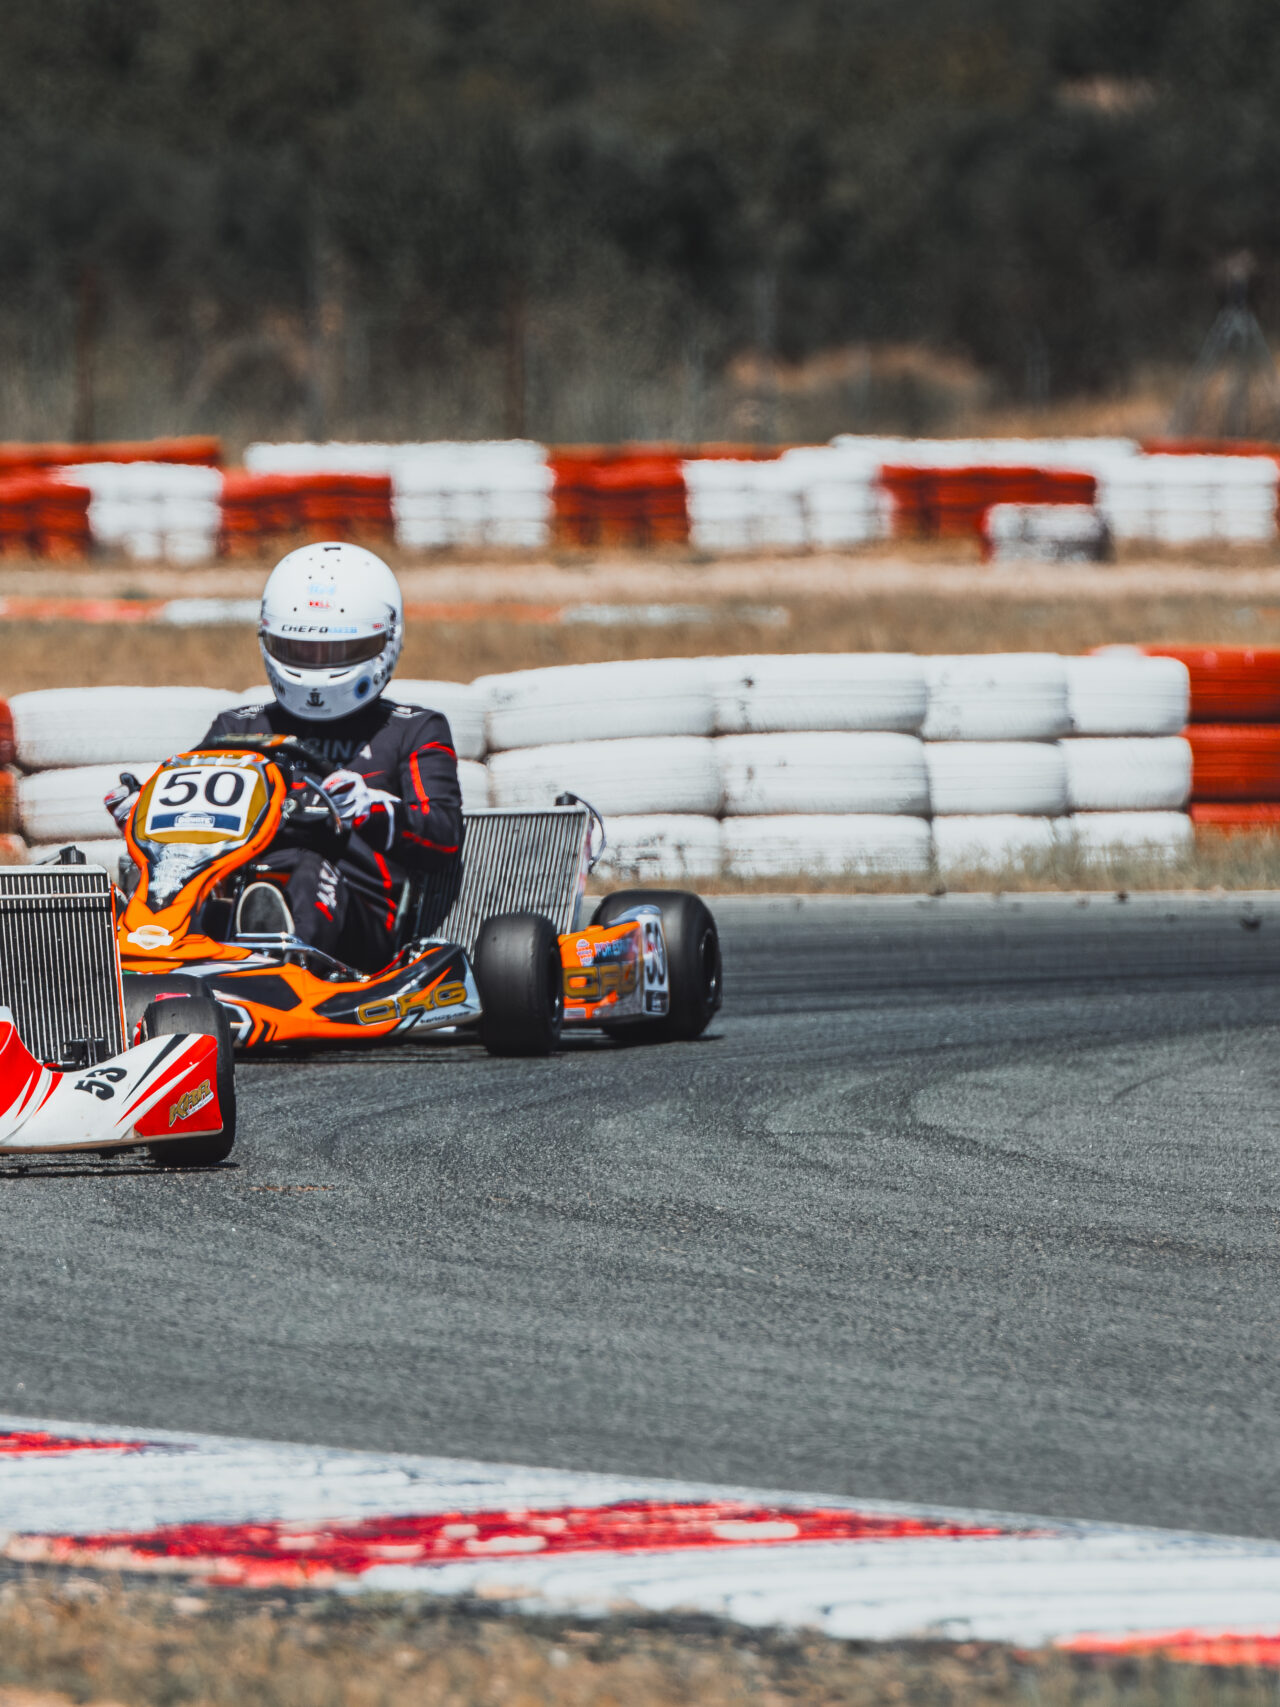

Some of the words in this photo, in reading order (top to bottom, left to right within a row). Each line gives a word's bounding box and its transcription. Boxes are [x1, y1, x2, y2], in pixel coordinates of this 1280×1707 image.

[159, 771, 245, 807] 50
[356, 980, 467, 1025] CRG
[74, 1067, 127, 1101] 53
